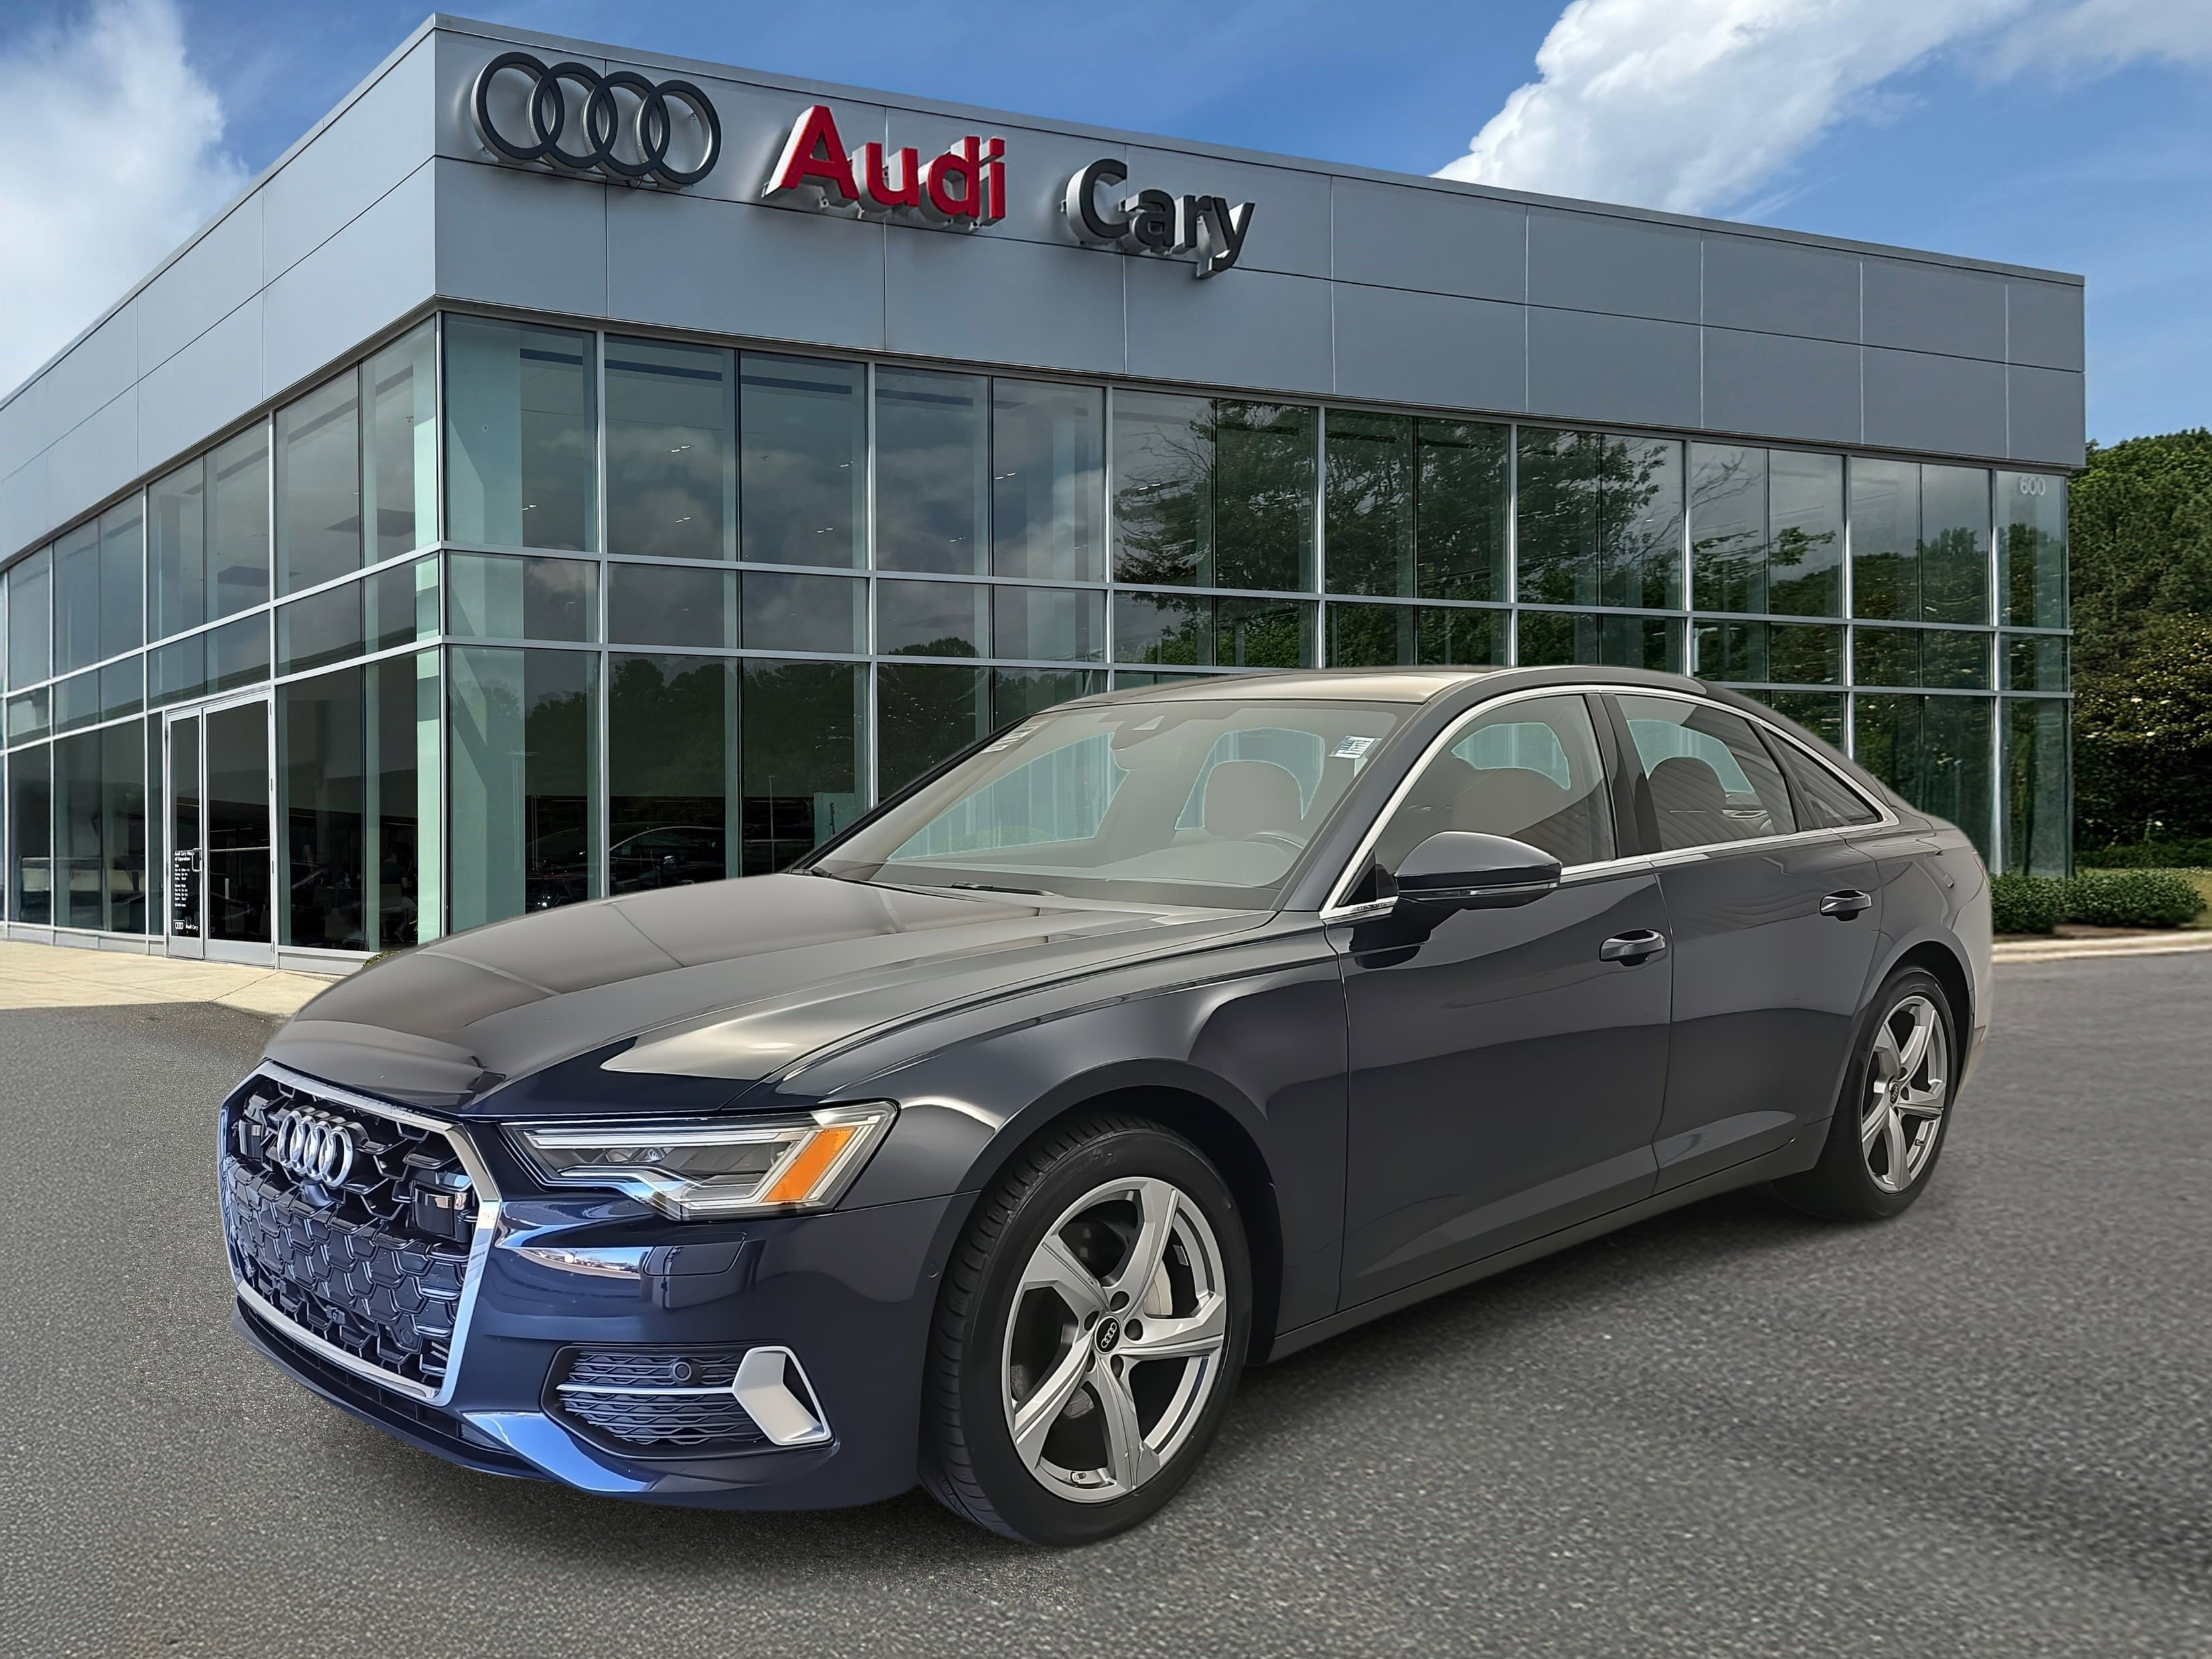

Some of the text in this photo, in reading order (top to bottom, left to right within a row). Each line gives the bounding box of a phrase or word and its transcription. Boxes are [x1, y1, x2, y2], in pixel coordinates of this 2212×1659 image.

[778, 104, 1257, 272] Audi Cary
[2020, 476, 2046, 495] 600
